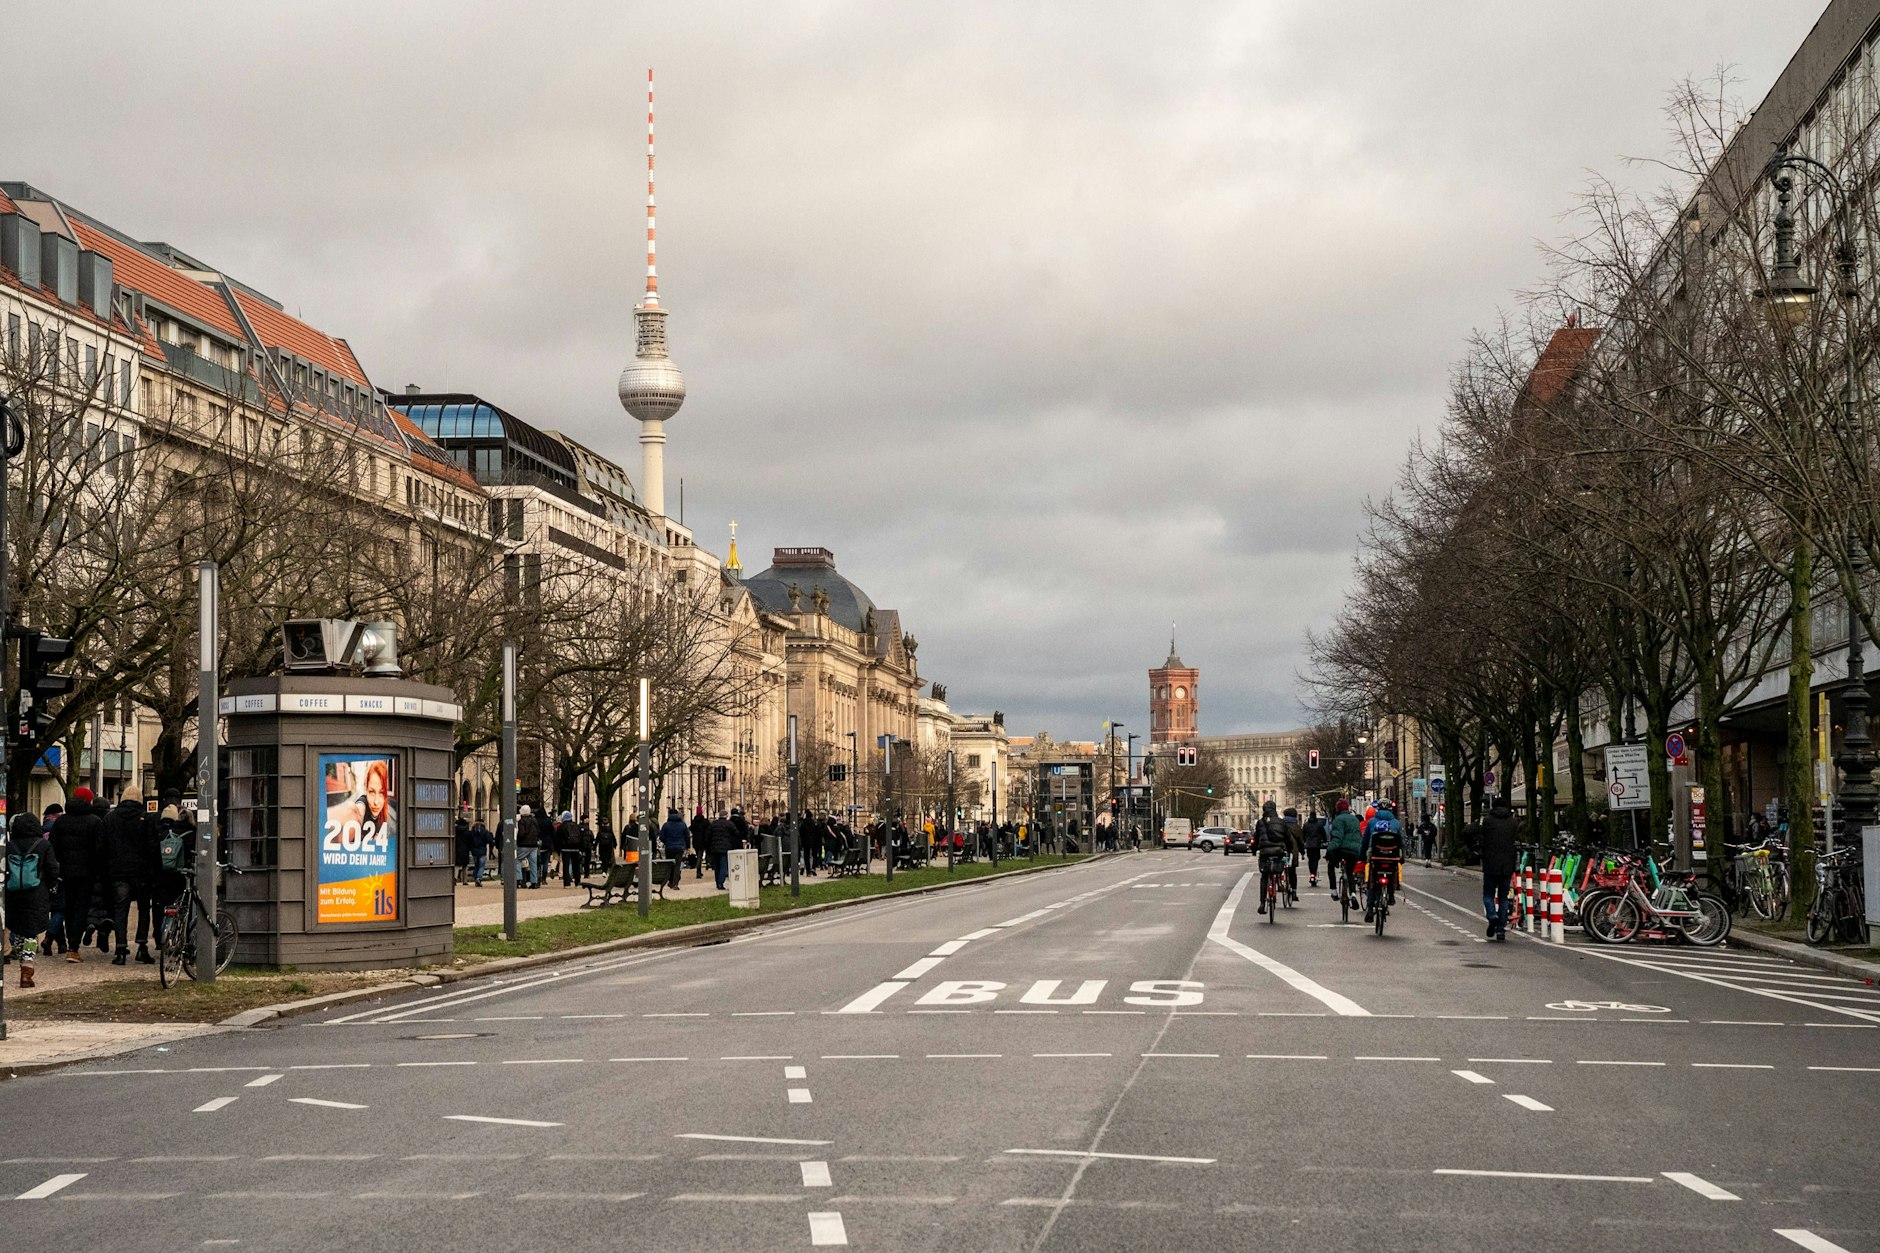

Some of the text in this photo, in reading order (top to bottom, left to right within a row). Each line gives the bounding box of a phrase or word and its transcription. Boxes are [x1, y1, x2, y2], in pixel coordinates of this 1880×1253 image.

[244, 699, 264, 709] COFFEE
[299, 698, 328, 708] COFFEE
[360, 699, 383, 709] SNACKS
[1053, 766, 1060, 775] U
[323, 820, 389, 853] 2024
[322, 852, 387, 867] WIRD DEIN JAHR!
[319, 887, 357, 897] Mit Bildung
[374, 888, 394, 916] ils
[913, 979, 1205, 1007] BUS
